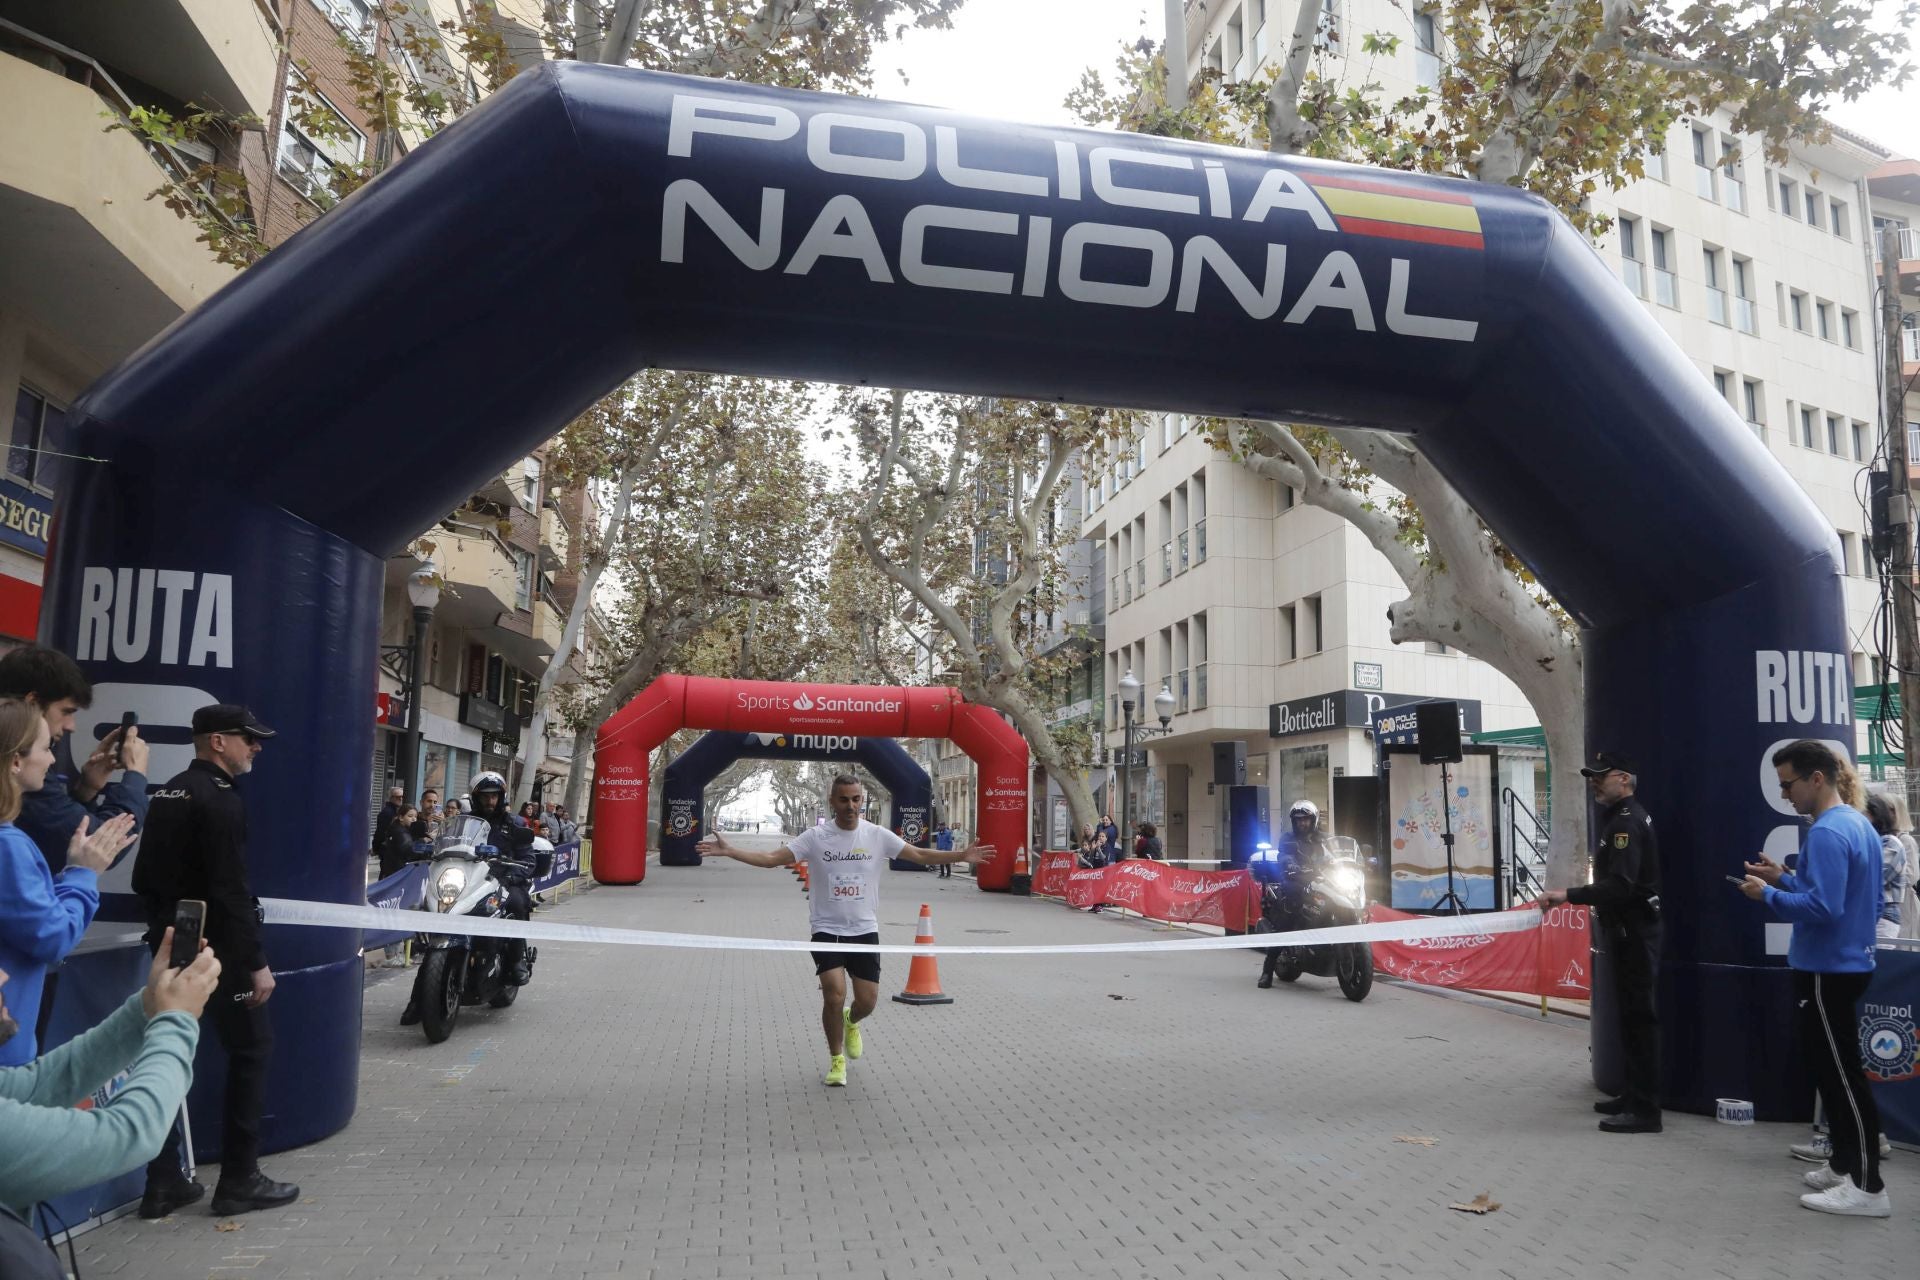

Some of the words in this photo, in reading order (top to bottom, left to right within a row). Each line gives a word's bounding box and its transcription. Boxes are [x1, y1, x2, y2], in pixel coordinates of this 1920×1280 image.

[660, 178, 1480, 342] NACIONAL
[76, 566, 233, 669] RUTA
[1756, 649, 1850, 726] RUTA
[737, 692, 790, 712] Sports
[816, 696, 902, 713] Santander
[789, 716, 844, 724] sportssantander.es
[1278, 698, 1336, 735] Botticelli
[1395, 712, 1417, 723] POLIC
[1396, 720, 1417, 731] NACIO
[608, 764, 634, 774] Sports
[606, 778, 643, 786] Santander
[996, 776, 1020, 785] Sports
[834, 886, 860, 896] 3401
[1864, 1003, 1913, 1019] mupol
